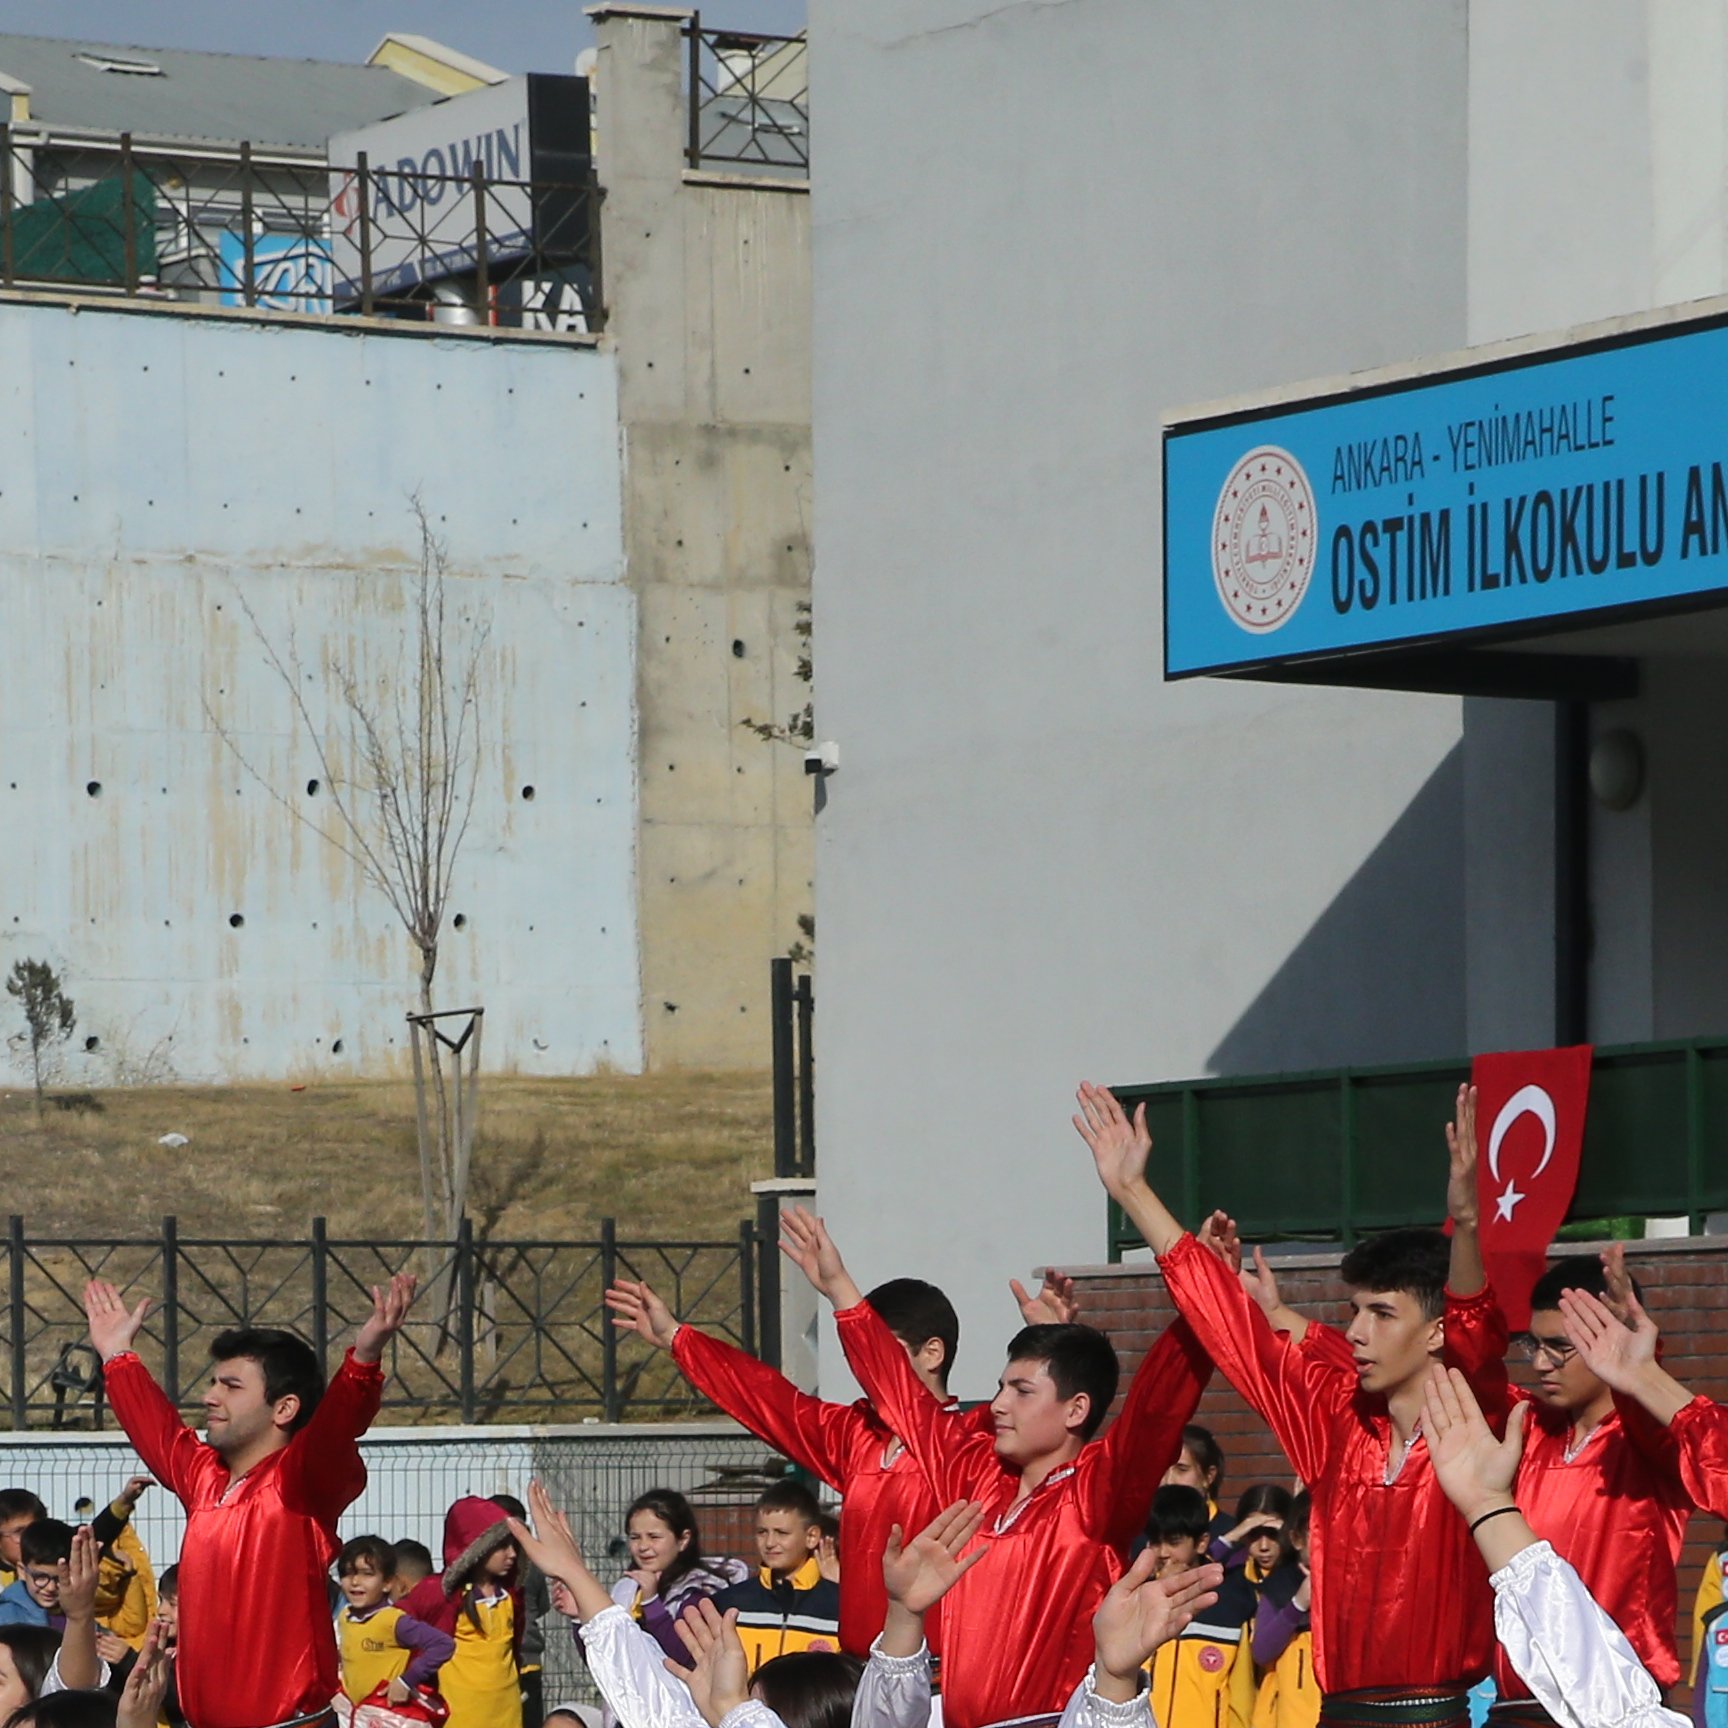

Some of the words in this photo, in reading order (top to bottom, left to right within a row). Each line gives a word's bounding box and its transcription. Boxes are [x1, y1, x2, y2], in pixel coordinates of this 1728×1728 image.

[1331, 431, 1425, 495] ANKARA
[1447, 395, 1615, 474] YENİMAHALLE
[1331, 492, 1451, 615] OSTİM
[1467, 471, 1666, 593] İLKOKULU
